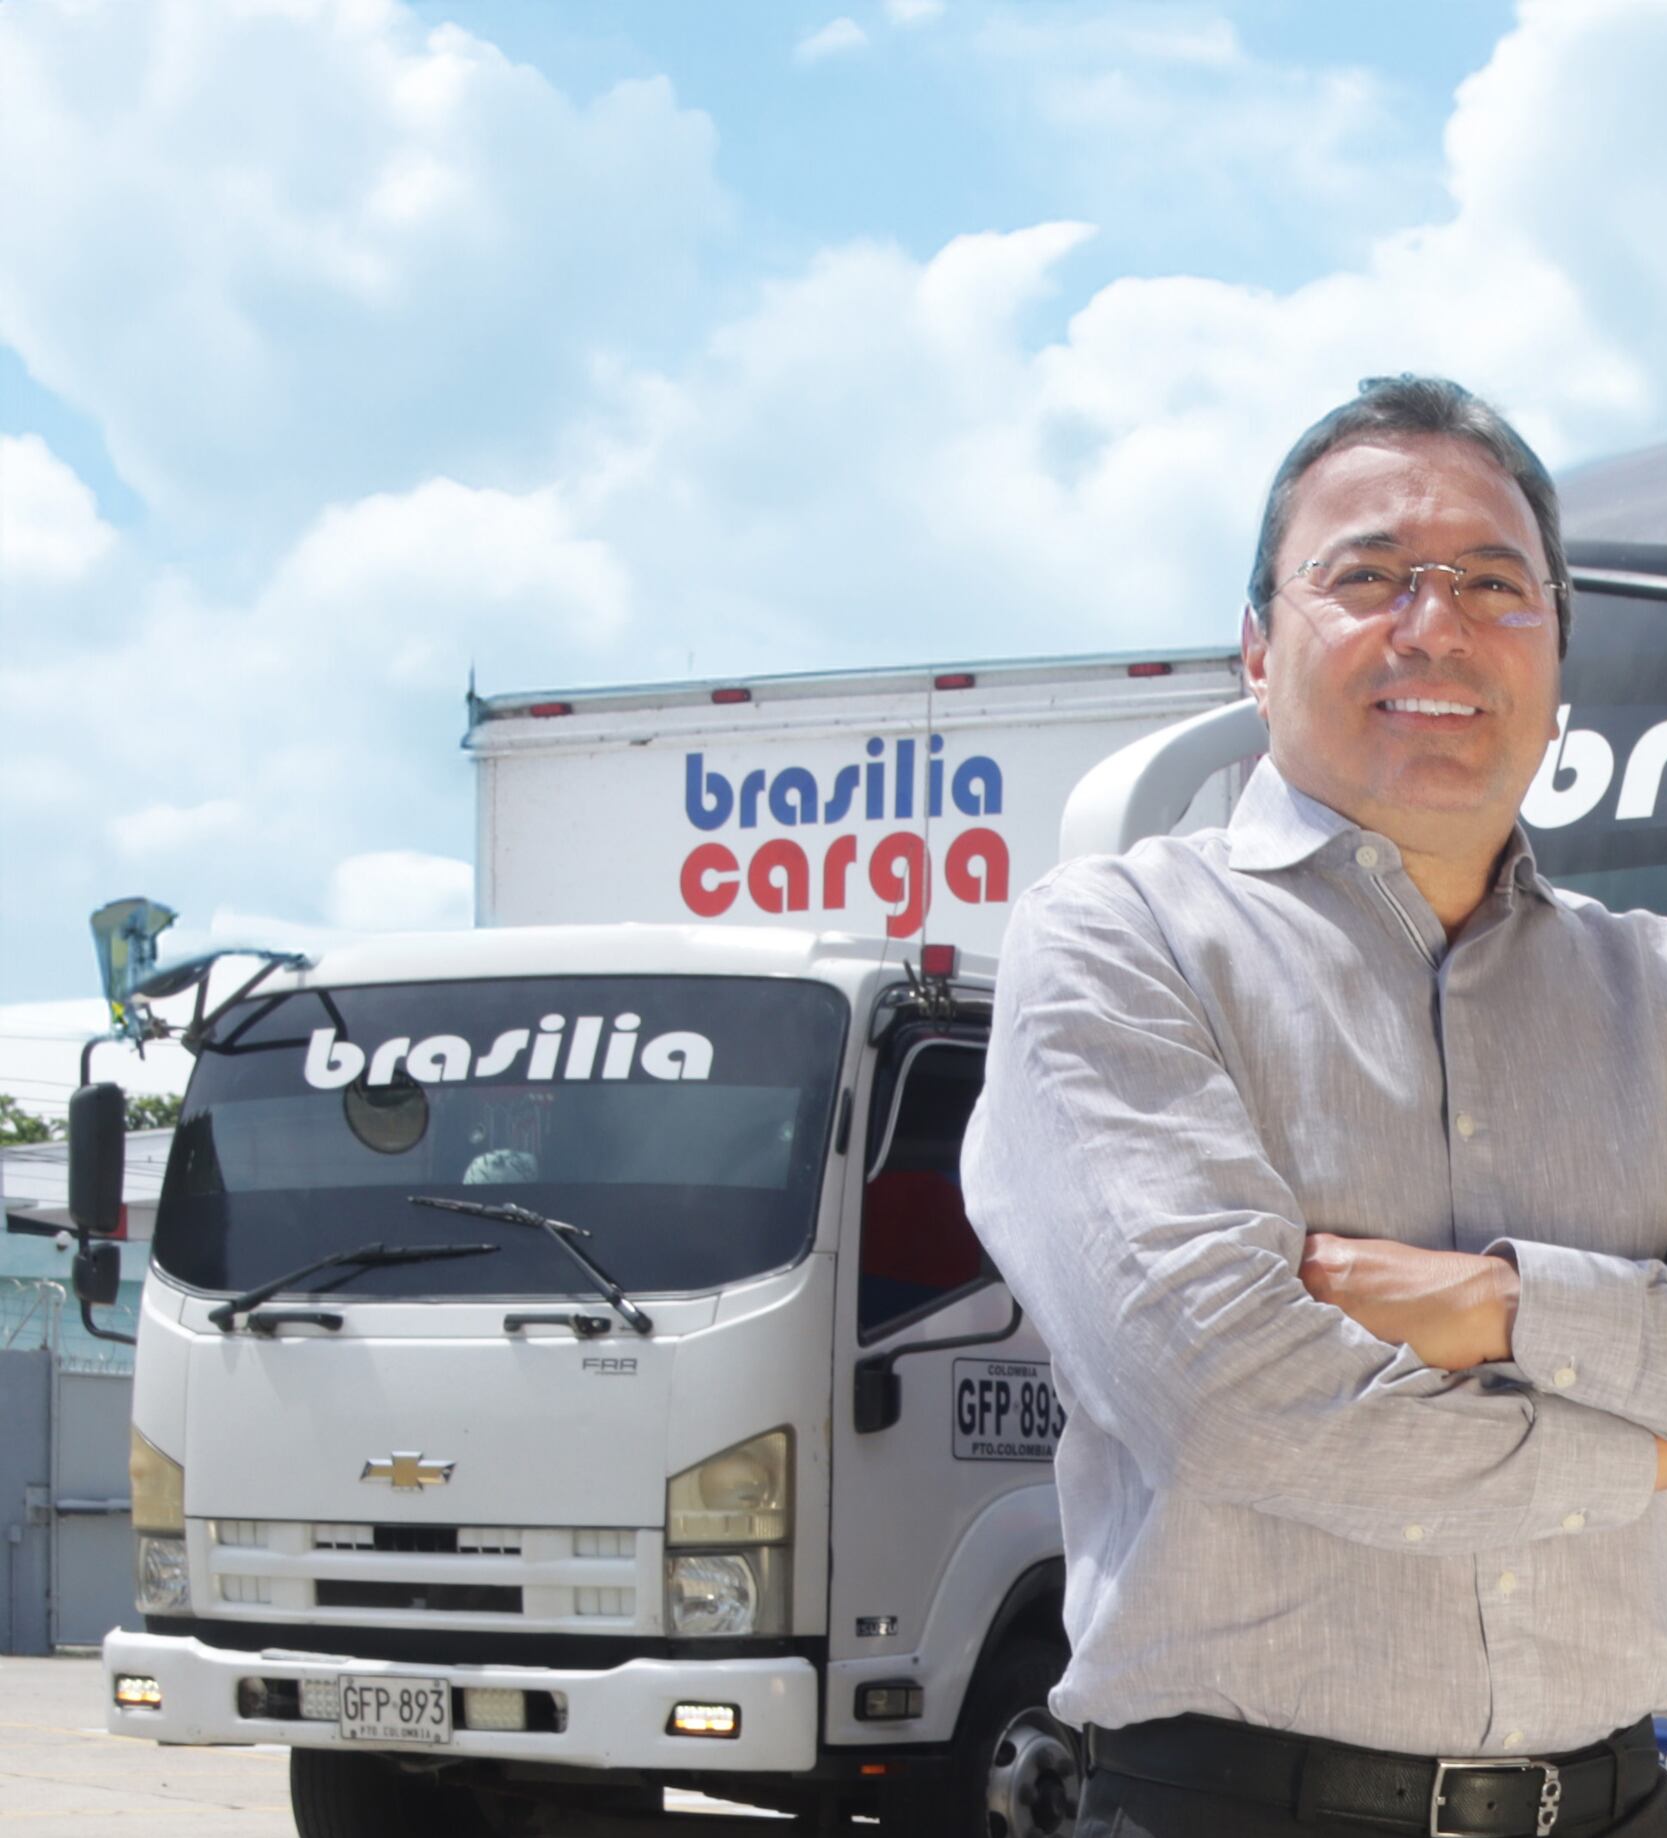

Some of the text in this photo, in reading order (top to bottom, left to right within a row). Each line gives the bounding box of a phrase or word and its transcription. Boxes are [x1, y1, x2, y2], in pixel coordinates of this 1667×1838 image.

[684, 733, 1003, 831] brasilia
[680, 827, 1010, 939] carga
[303, 1012, 715, 1091] brasilia
[987, 1364, 1038, 1378] COLOMBIA
[957, 1377, 1011, 1437] GFP
[343, 1686, 445, 1725] GFP 893
